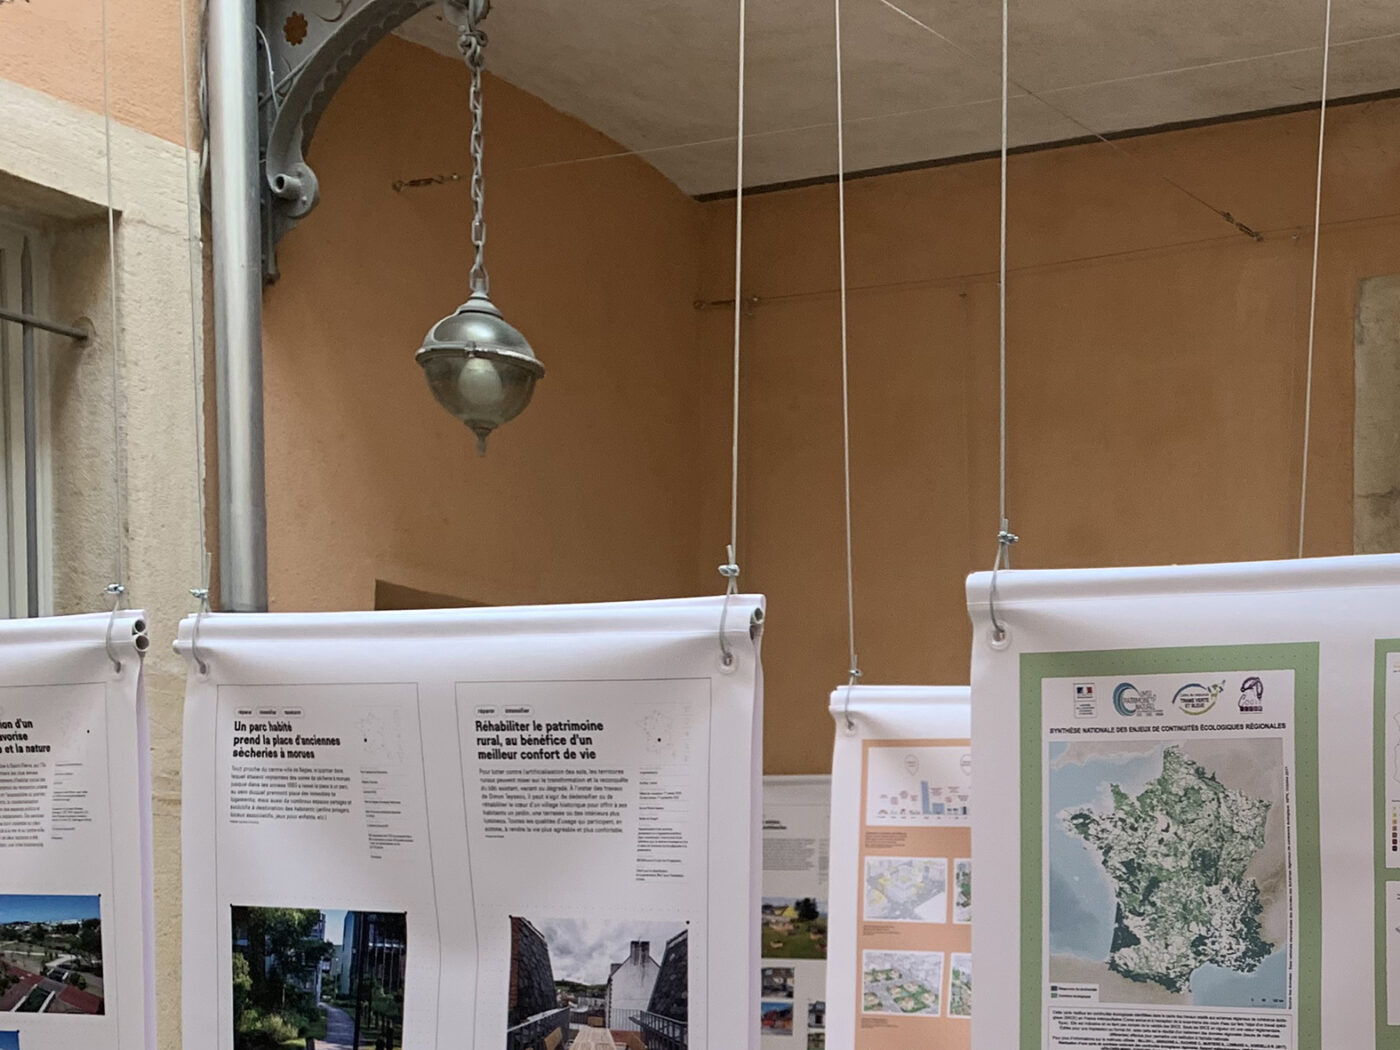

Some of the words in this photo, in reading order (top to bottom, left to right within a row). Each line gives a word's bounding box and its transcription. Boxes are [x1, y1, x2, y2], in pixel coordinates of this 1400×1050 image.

[14, 718, 33, 728] d'un
[234, 720, 246, 731] Un
[249, 723, 267, 734] parc
[267, 720, 292, 732] habité
[475, 720, 529, 732] Réhabiliter
[532, 720, 542, 731] le
[545, 719, 603, 734] patrimoine
[1049, 726, 1080, 734] SYNTHÈSE
[1160, 724, 1199, 732] CONTINUITÉS
[1199, 723, 1244, 731] ÉCOLOGIQUES
[1245, 722, 1286, 730] RÉGIONALES
[233, 734, 260, 746] prend
[262, 734, 270, 745] la
[272, 734, 293, 747] place
[295, 734, 340, 746] d'anciennes
[476, 734, 502, 747] rural,
[504, 737, 517, 746] au
[520, 733, 566, 745] bénéfice
[569, 733, 592, 745] d'un
[4, 744, 14, 753] et
[14, 743, 24, 753] la
[25, 744, 50, 753] nature
[232, 746, 278, 758] sécheries
[279, 747, 285, 758] à
[286, 750, 314, 759] morues
[478, 748, 517, 760] meilleur
[520, 748, 560, 760] confort
[562, 747, 576, 759] de
[579, 747, 596, 759] vie
